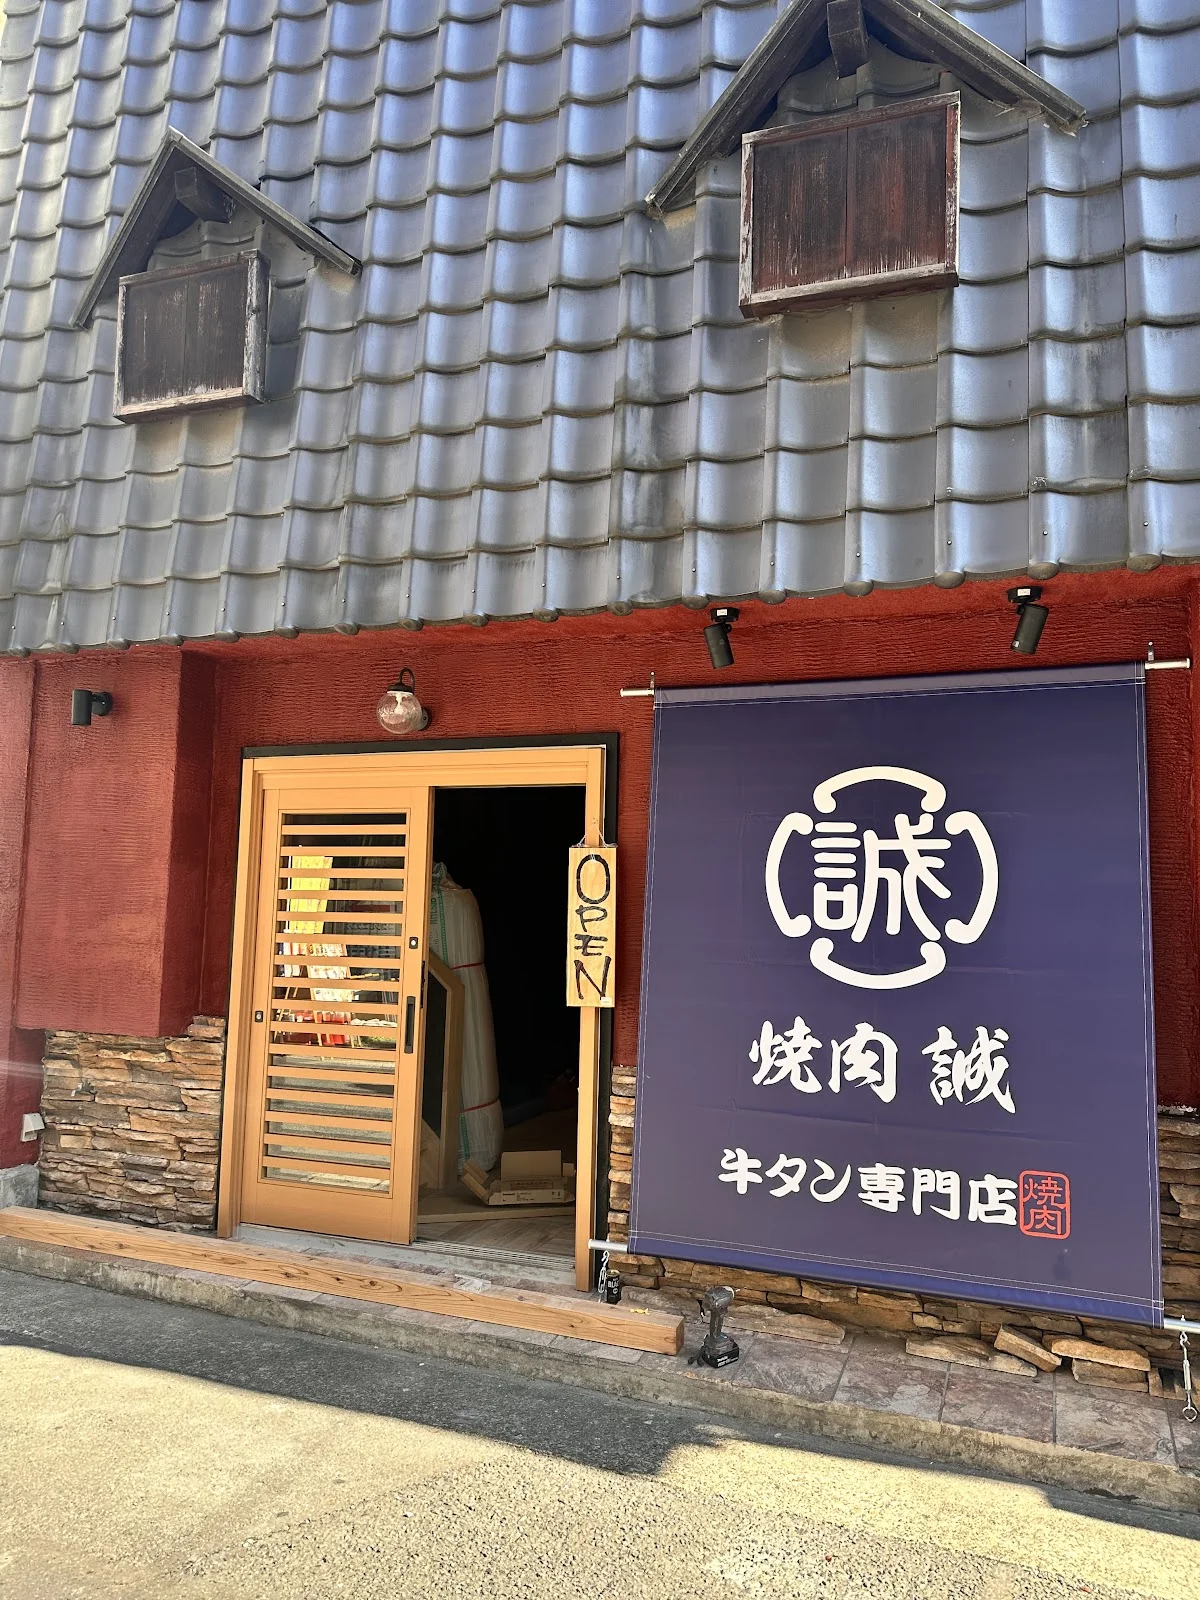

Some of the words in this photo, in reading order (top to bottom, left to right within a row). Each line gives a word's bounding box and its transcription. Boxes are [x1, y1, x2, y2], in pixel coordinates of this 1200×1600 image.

[810, 810, 953, 943] 誠
[574, 853, 612, 1001] OPEN
[748, 1015, 899, 1103] 焼肉
[921, 1025, 1017, 1114] 誠
[718, 1147, 1018, 1226] 牛タン専門店
[1024, 1175, 1066, 1236] 焼肉
